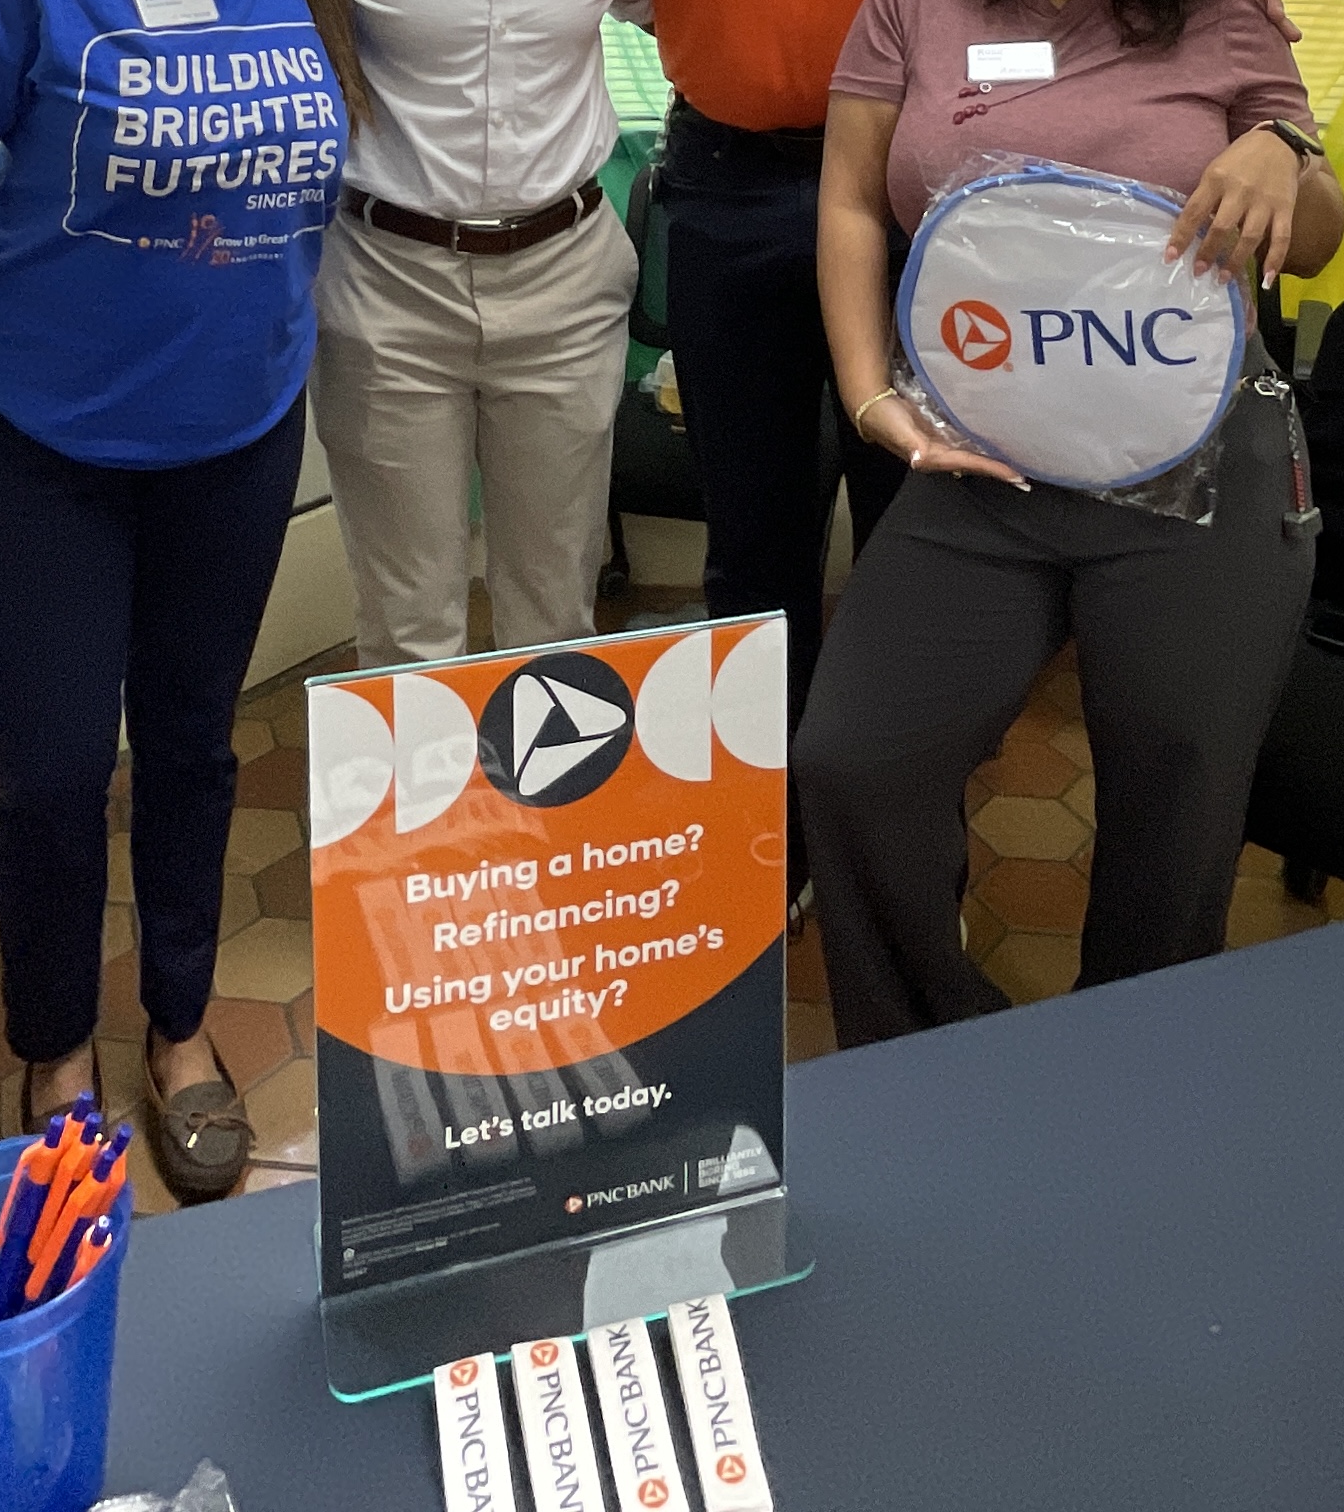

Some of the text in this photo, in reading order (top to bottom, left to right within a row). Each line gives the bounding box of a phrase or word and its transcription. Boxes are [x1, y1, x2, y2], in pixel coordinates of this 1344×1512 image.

[119, 47, 323, 97] BUILDING
[113, 91, 339, 148] BRIGHTER
[106, 139, 338, 197] FUTURES
[246, 191, 297, 210] SINCE
[154, 238, 185, 248] PNC
[214, 237, 243, 247] Grow
[258, 234, 289, 245] Great
[1020, 308, 1197, 366] PNC
[406, 823, 704, 904] Buying a home?
[433, 880, 681, 953] Refinancing?
[384, 925, 725, 1014] Using your home's
[489, 978, 629, 1032] equity?
[444, 1082, 674, 1150] Let's talk today.
[536, 1369, 585, 1512] PNCBAN
